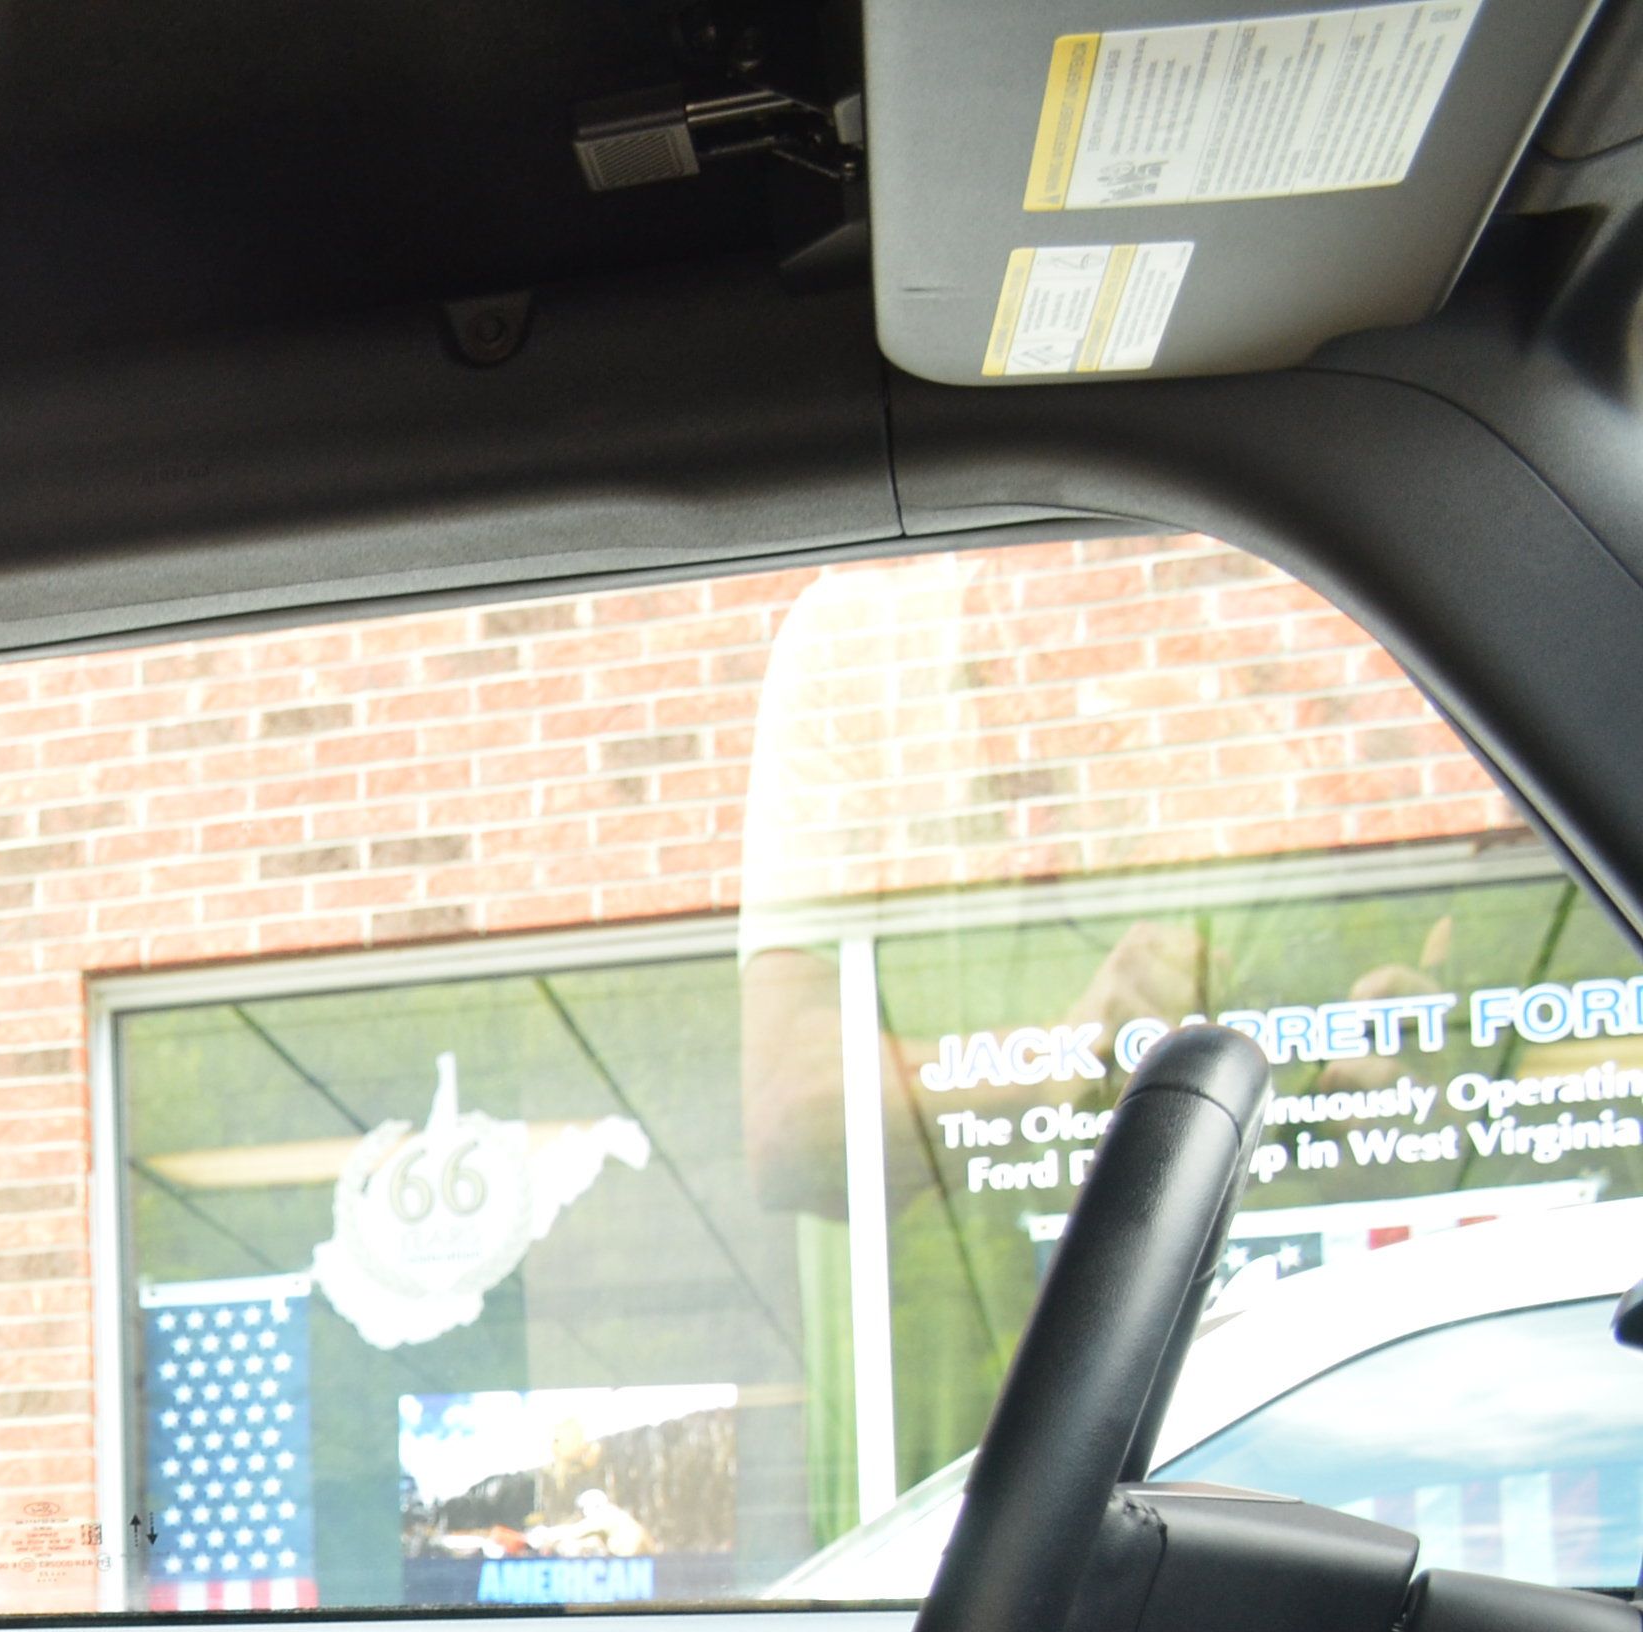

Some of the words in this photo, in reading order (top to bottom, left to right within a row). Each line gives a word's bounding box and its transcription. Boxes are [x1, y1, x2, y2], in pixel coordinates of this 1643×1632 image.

[919, 1022, 1106, 1091] JACK
[1114, 993, 1457, 1073] GRRETT
[938, 1110, 1012, 1149] The
[1264, 1076, 1437, 1125] inuously
[967, 1149, 1059, 1193] Ford
[1297, 1131, 1339, 1170] in
[1348, 1126, 1458, 1166] West
[1467, 1109, 1643, 1164] Virginia
[389, 1139, 489, 1225] 66
[477, 1557, 655, 1604] AMERICAN
